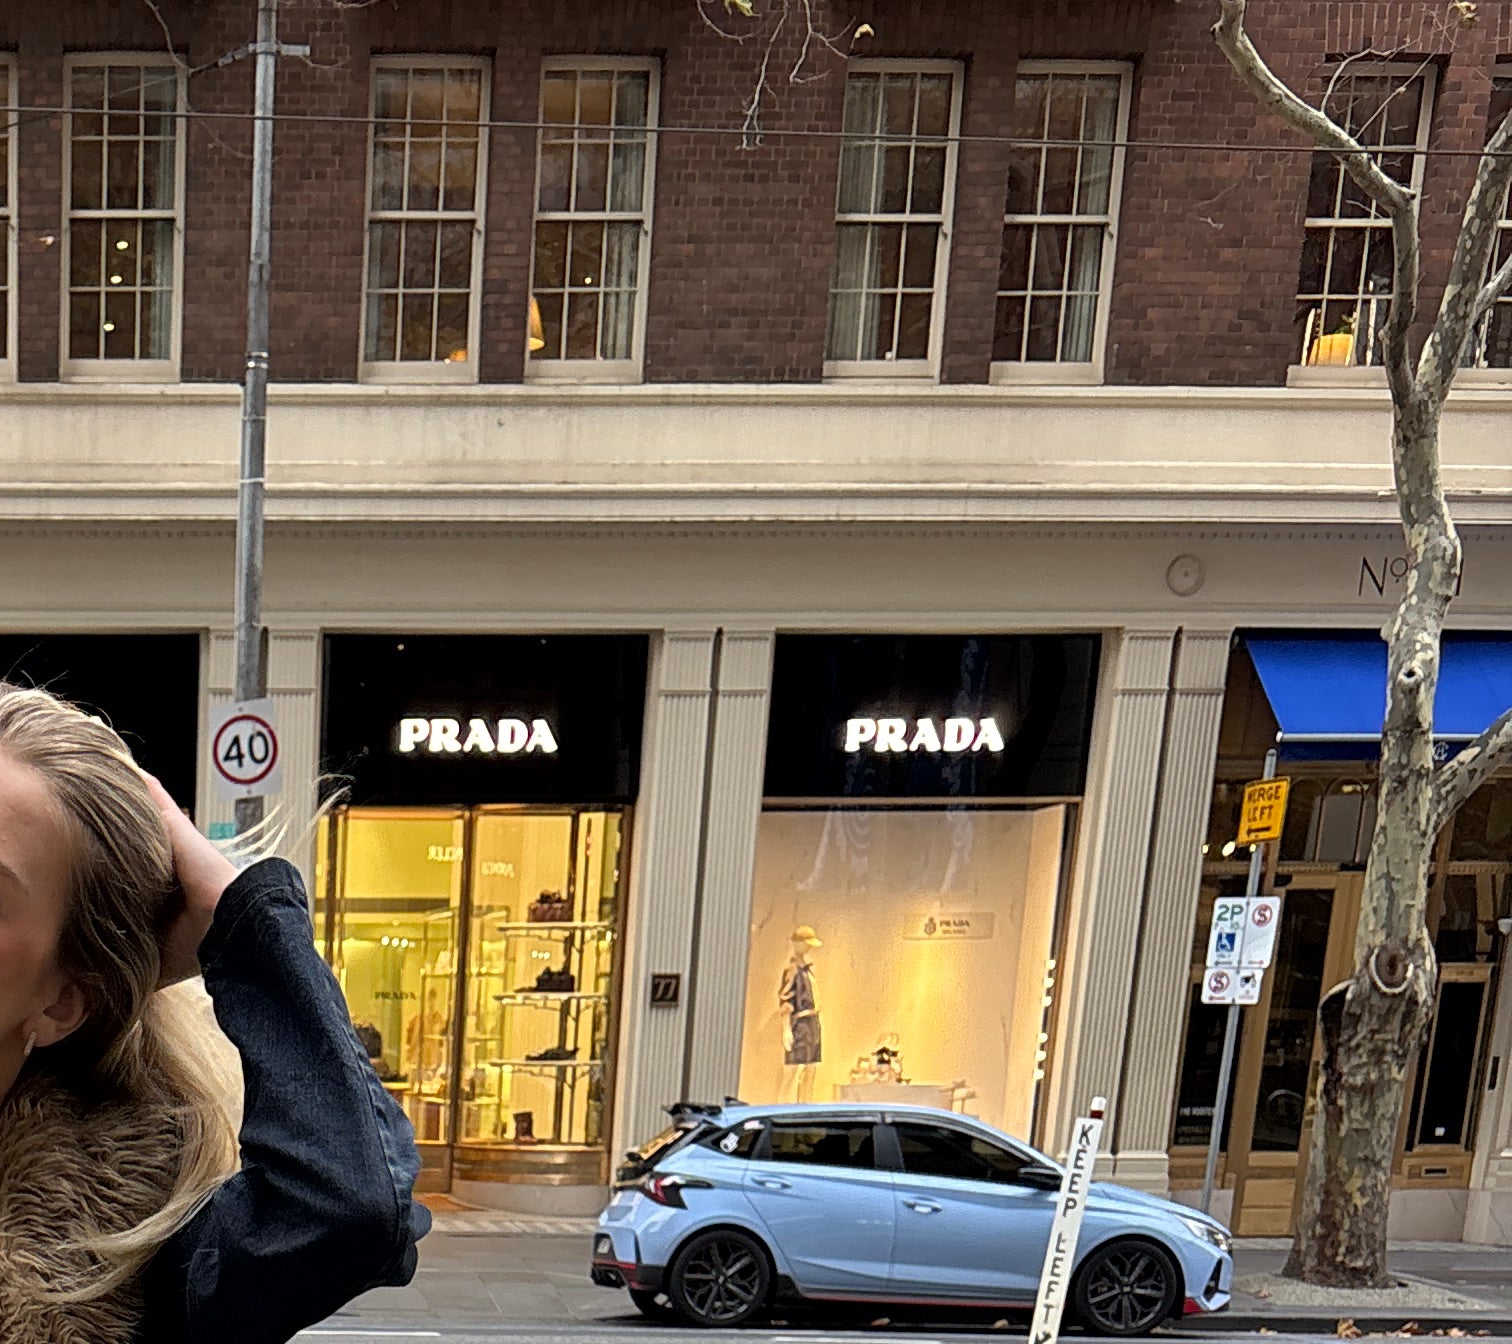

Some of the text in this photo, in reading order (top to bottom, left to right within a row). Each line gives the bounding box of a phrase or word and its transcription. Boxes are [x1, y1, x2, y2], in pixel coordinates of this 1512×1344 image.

[223, 731, 270, 769] 40
[399, 718, 559, 754] PRADA
[844, 718, 1005, 753] PRADA
[1246, 804, 1274, 823] LEFT
[1216, 904, 1244, 922] 2P
[654, 977, 678, 1000] 77
[1044, 1123, 1094, 1324] KEEP LEFT
